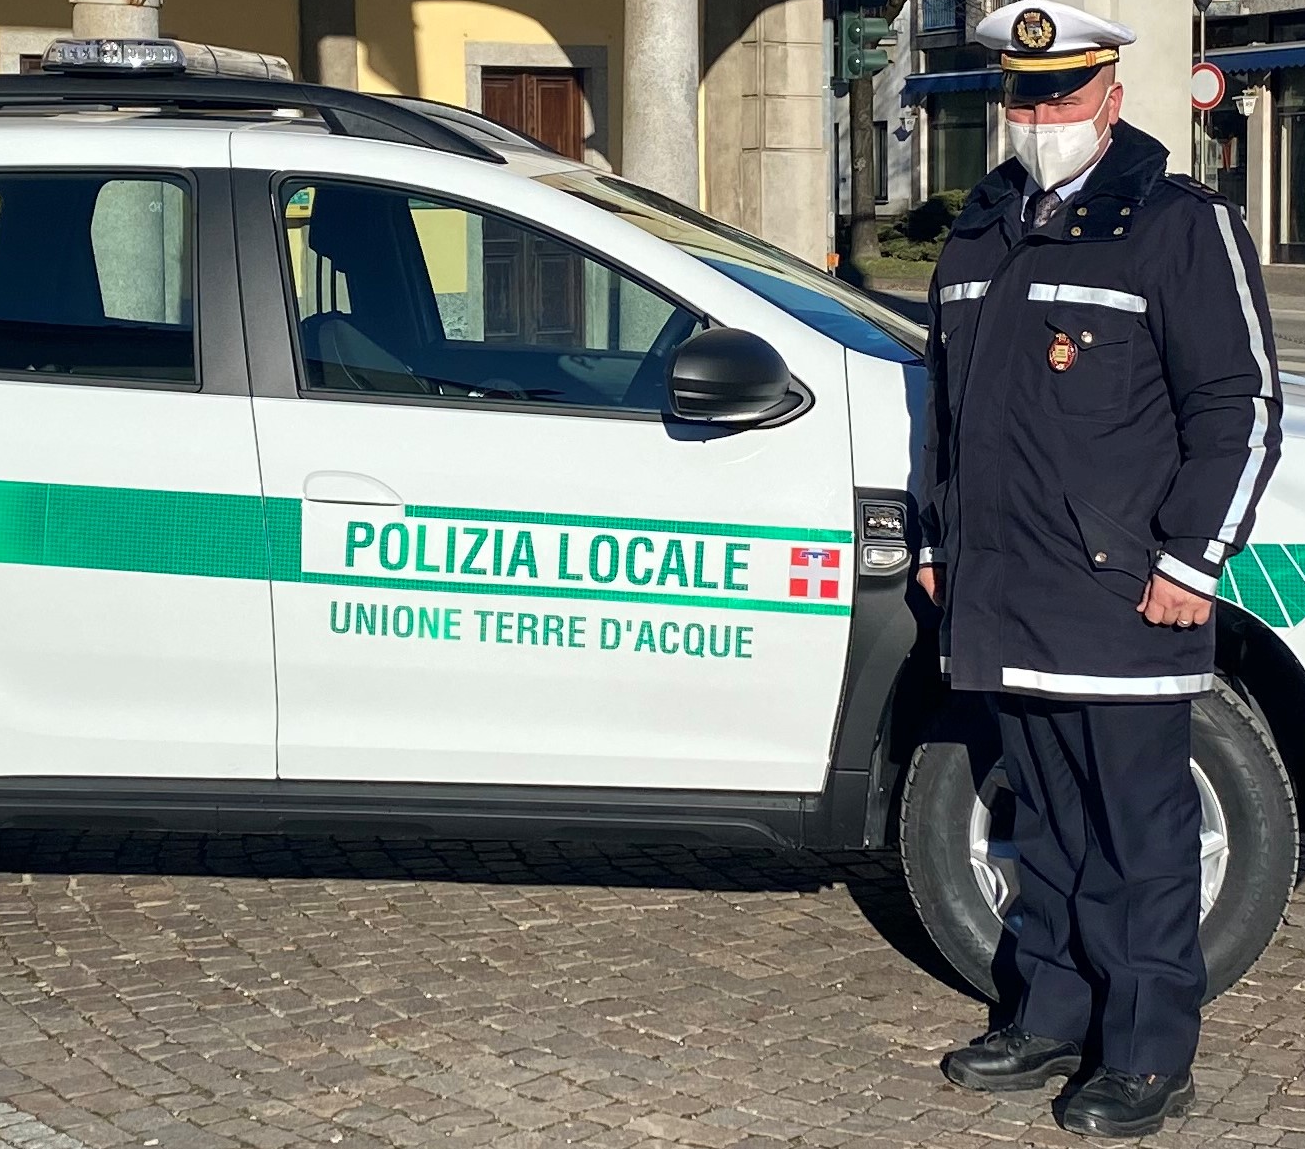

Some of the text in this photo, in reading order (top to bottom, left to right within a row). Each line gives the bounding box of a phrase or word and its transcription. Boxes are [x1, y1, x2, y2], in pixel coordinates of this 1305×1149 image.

[344, 520, 751, 592] POLIZIA LOCALE
[329, 600, 755, 660] UNIONE TERRE D'ACQUE
